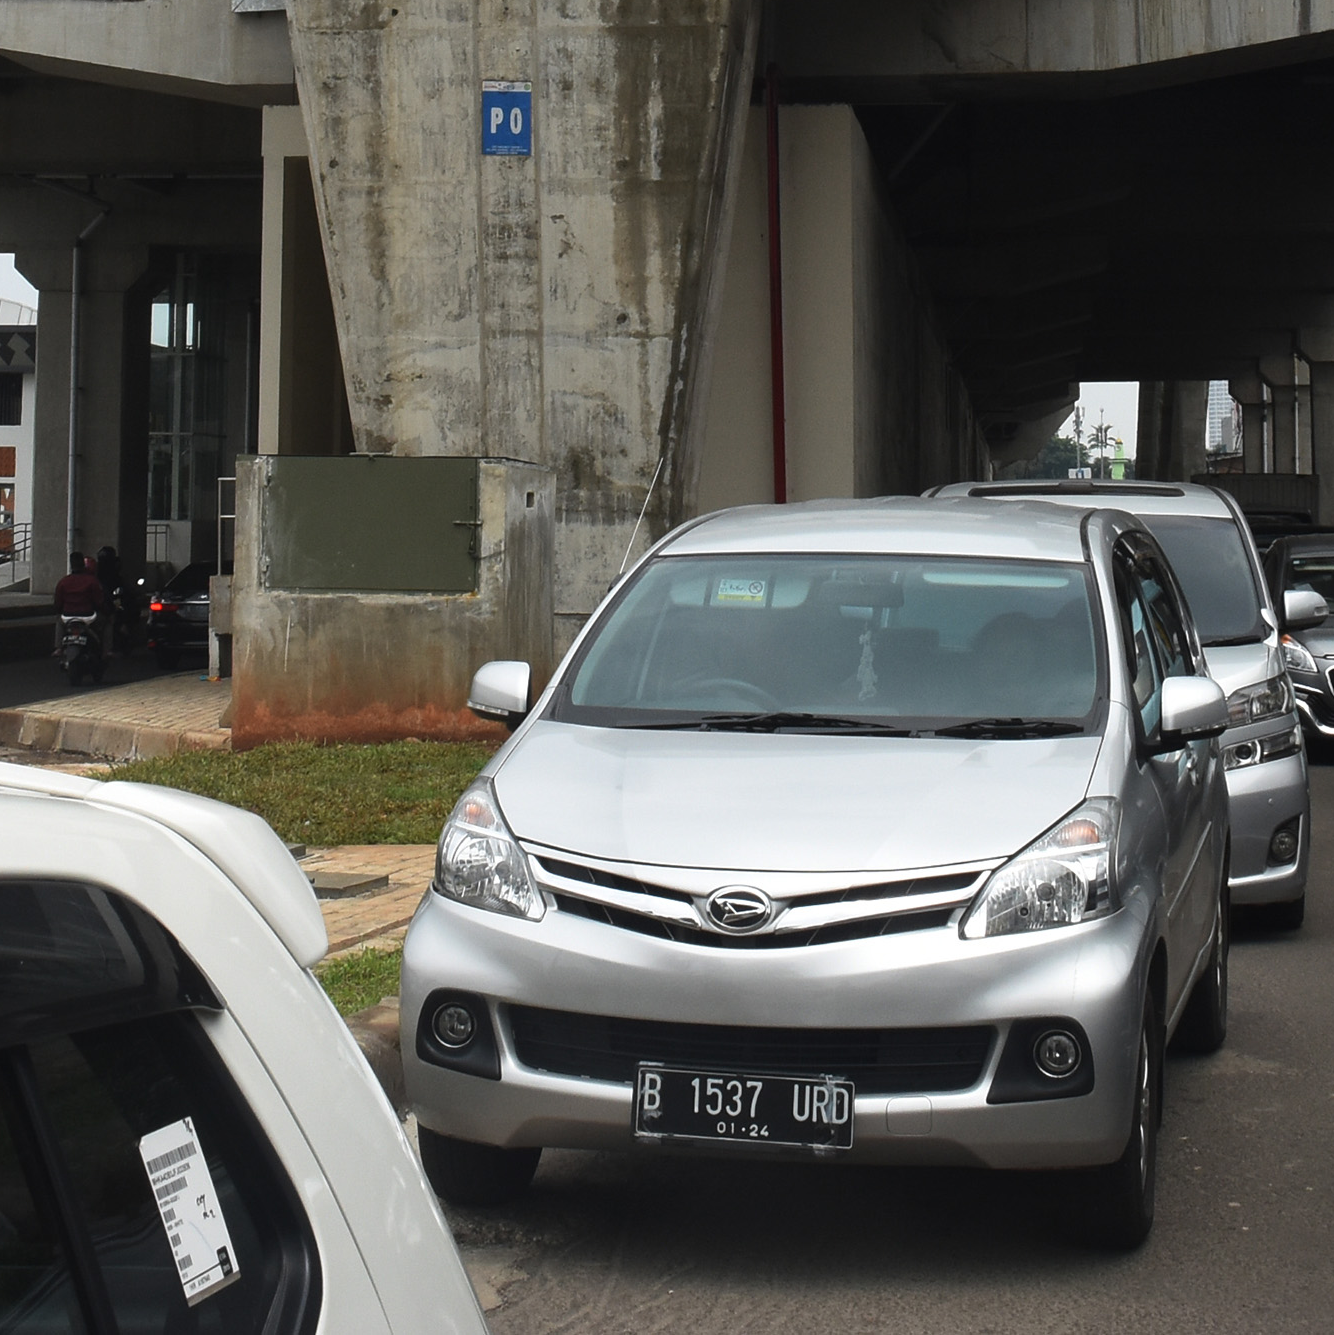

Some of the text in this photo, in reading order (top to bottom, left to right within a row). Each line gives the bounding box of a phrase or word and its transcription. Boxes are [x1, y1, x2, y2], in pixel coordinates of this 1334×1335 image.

[643, 1073, 850, 1125] B 1537 URD
